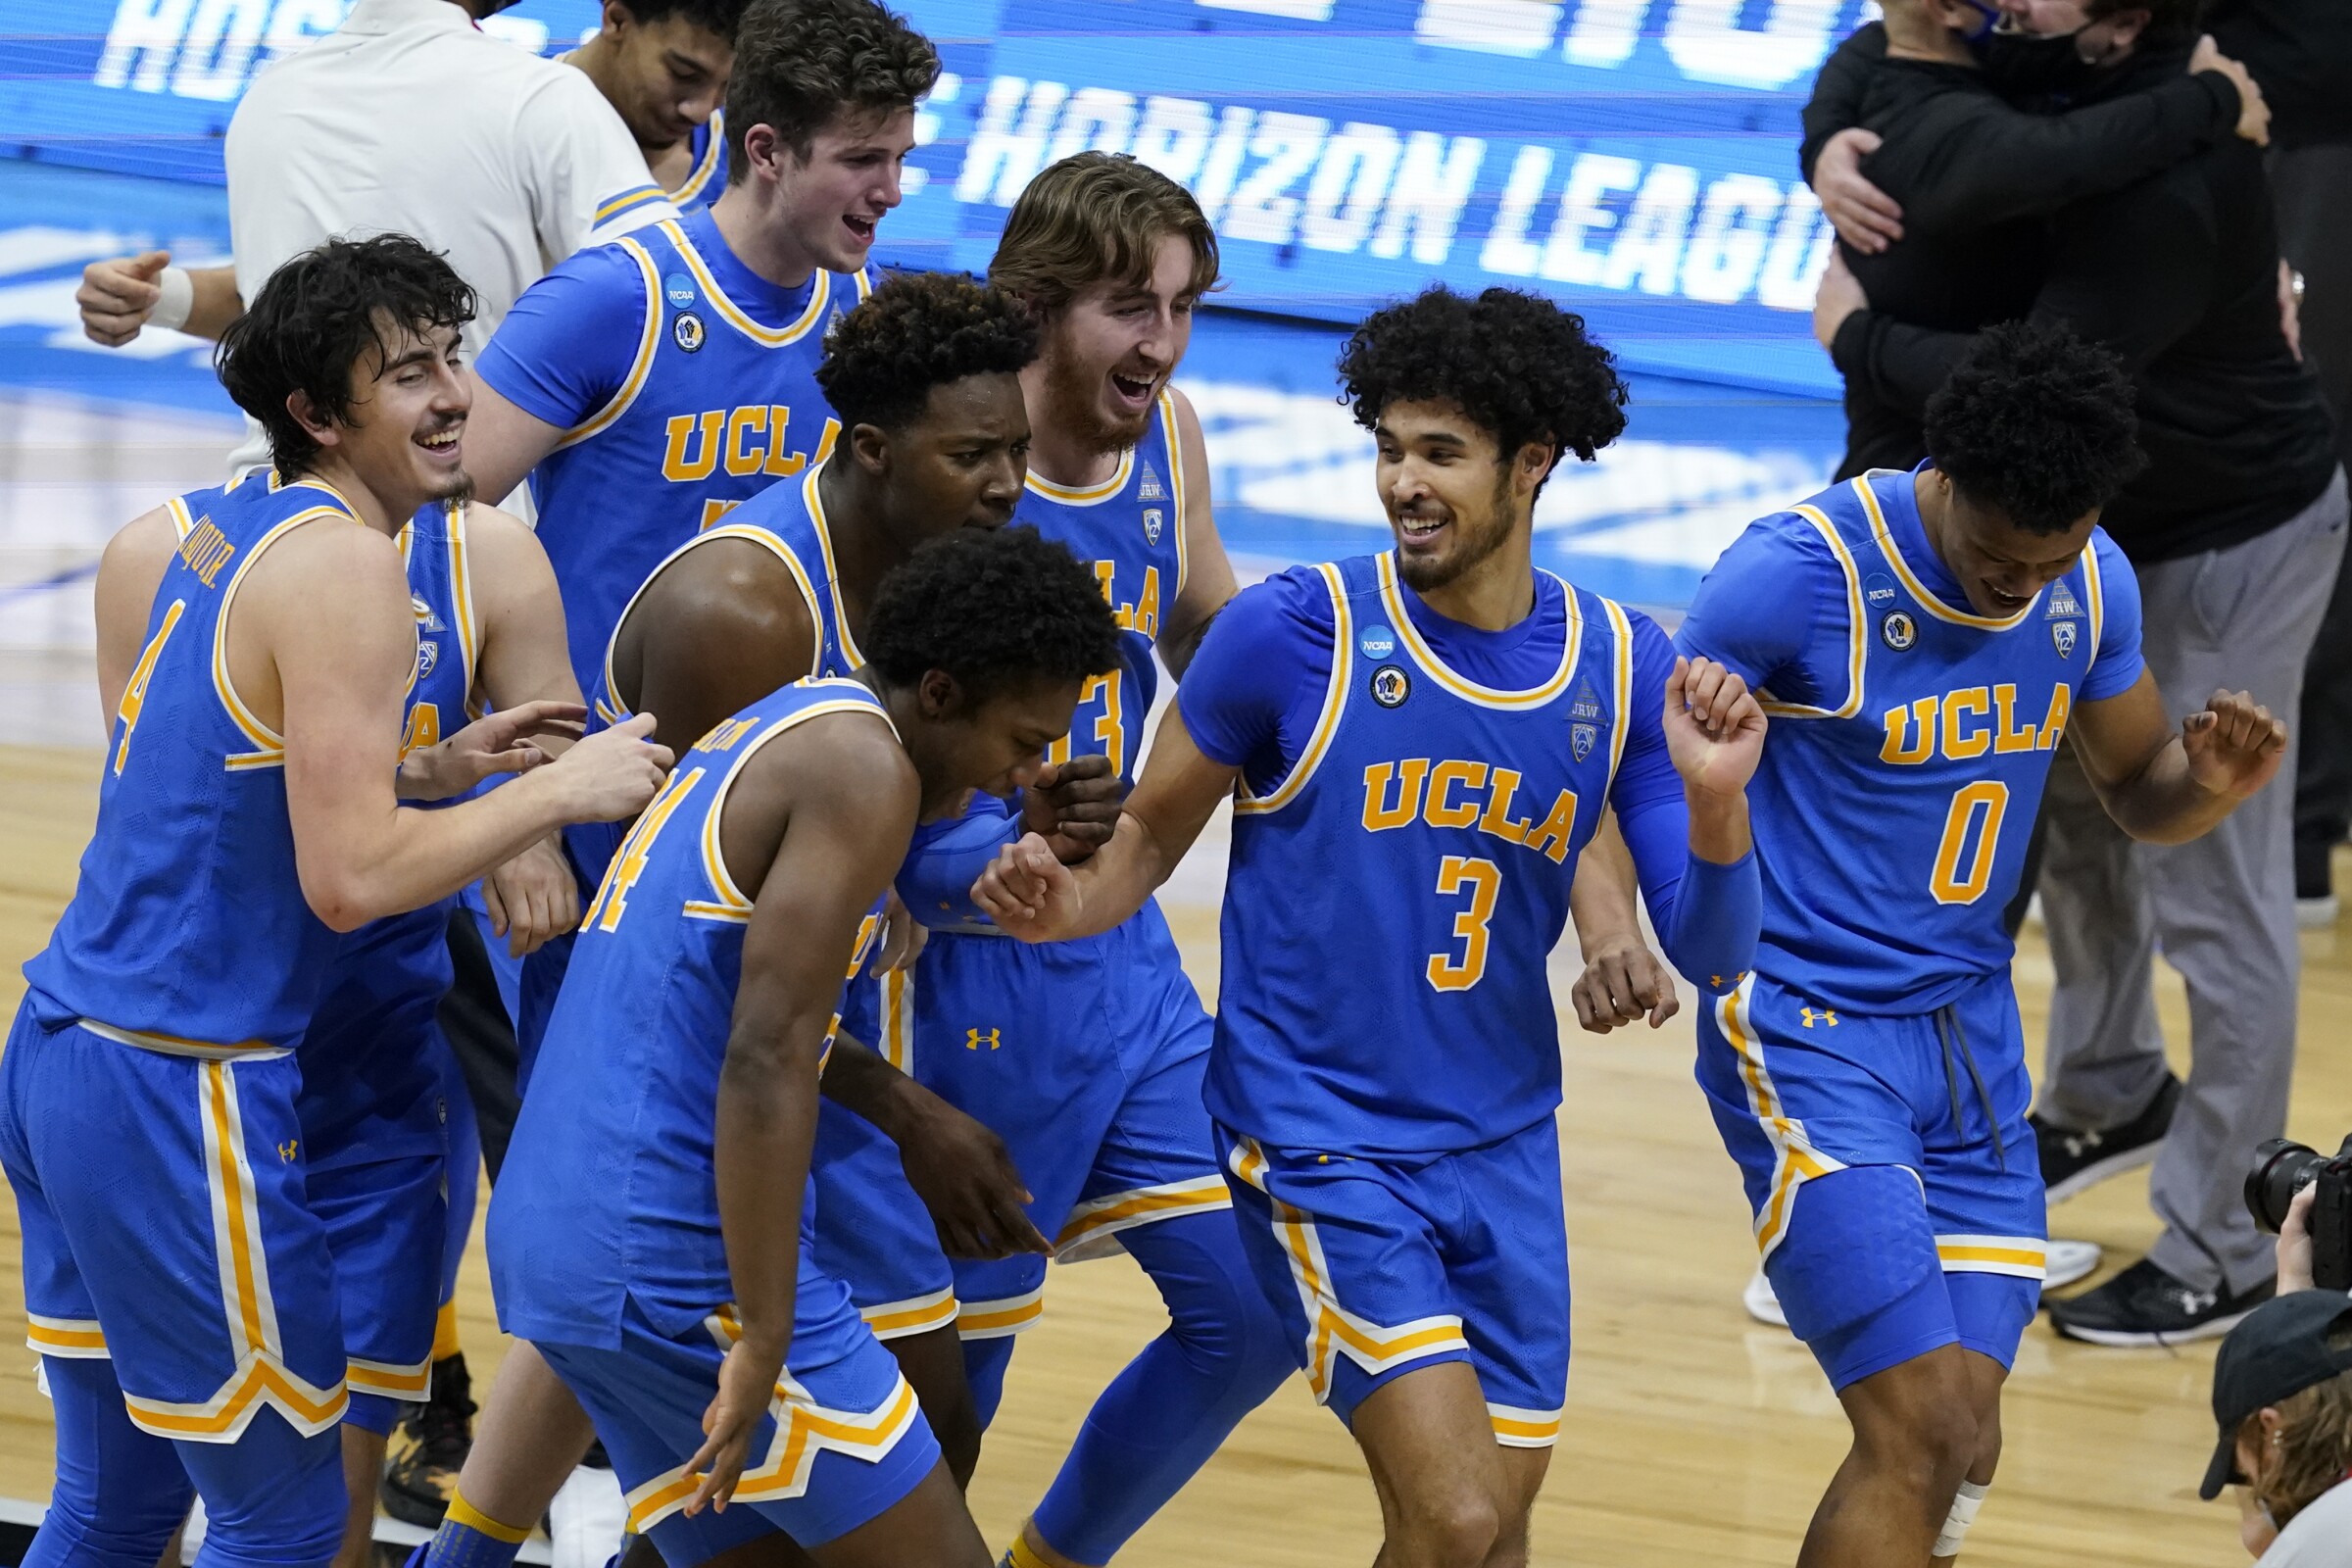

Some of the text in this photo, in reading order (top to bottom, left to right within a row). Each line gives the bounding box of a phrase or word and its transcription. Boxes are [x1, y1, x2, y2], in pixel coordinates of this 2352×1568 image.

[954, 74, 1488, 265] HORIZON
[1479, 144, 1835, 312] LEAGU
[668, 290, 695, 300] NCAA
[1140, 484, 1161, 497] JRW
[1869, 588, 1895, 601] NCAA
[2049, 600, 2075, 613] JRW
[1363, 641, 1394, 651] NCAA
[114, 598, 186, 779] 4
[1572, 703, 1598, 718] JRW
[1879, 681, 2072, 765] UCLA
[1361, 758, 1579, 865] UCLA
[1929, 780, 2010, 906] 0
[1426, 855, 1502, 993] 3
